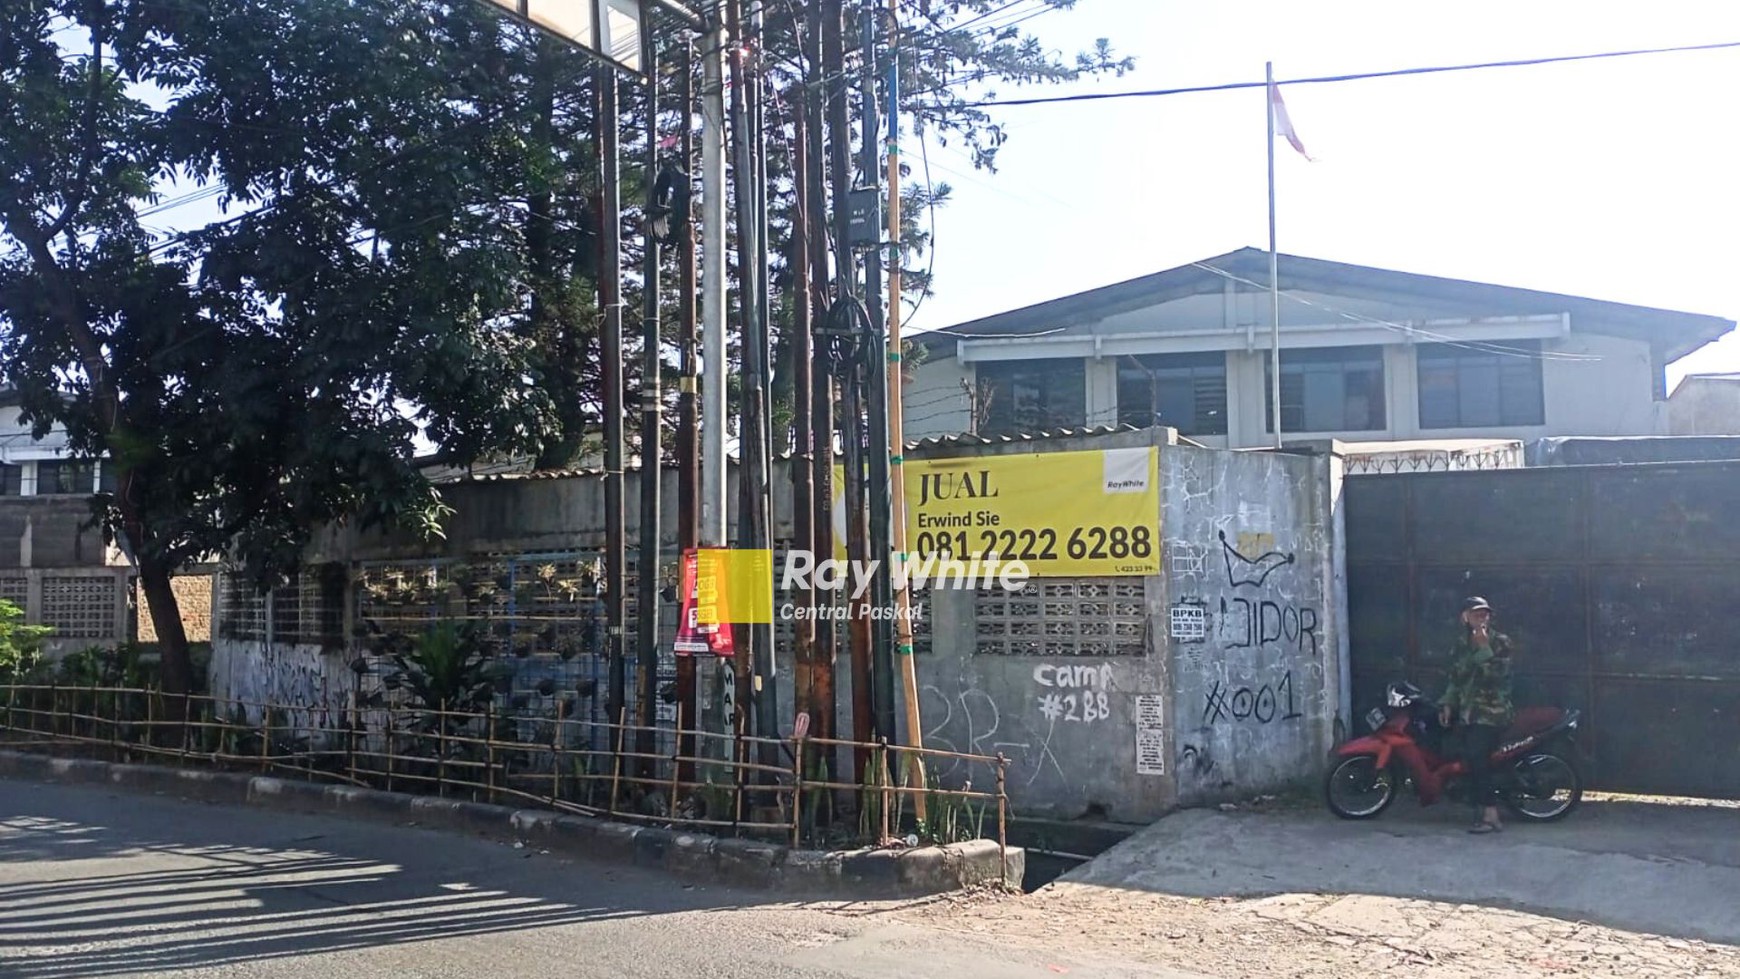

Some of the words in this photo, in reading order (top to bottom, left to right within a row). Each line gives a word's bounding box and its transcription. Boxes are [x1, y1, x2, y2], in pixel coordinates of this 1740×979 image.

[917, 470, 999, 507] JUAL
[917, 511, 972, 528] Erwind
[976, 510, 1000, 527] Sie
[917, 530, 971, 563] 081
[980, 528, 1058, 561] 2222
[1066, 525, 1151, 560] 6288
[1203, 669, 1303, 725] #001
